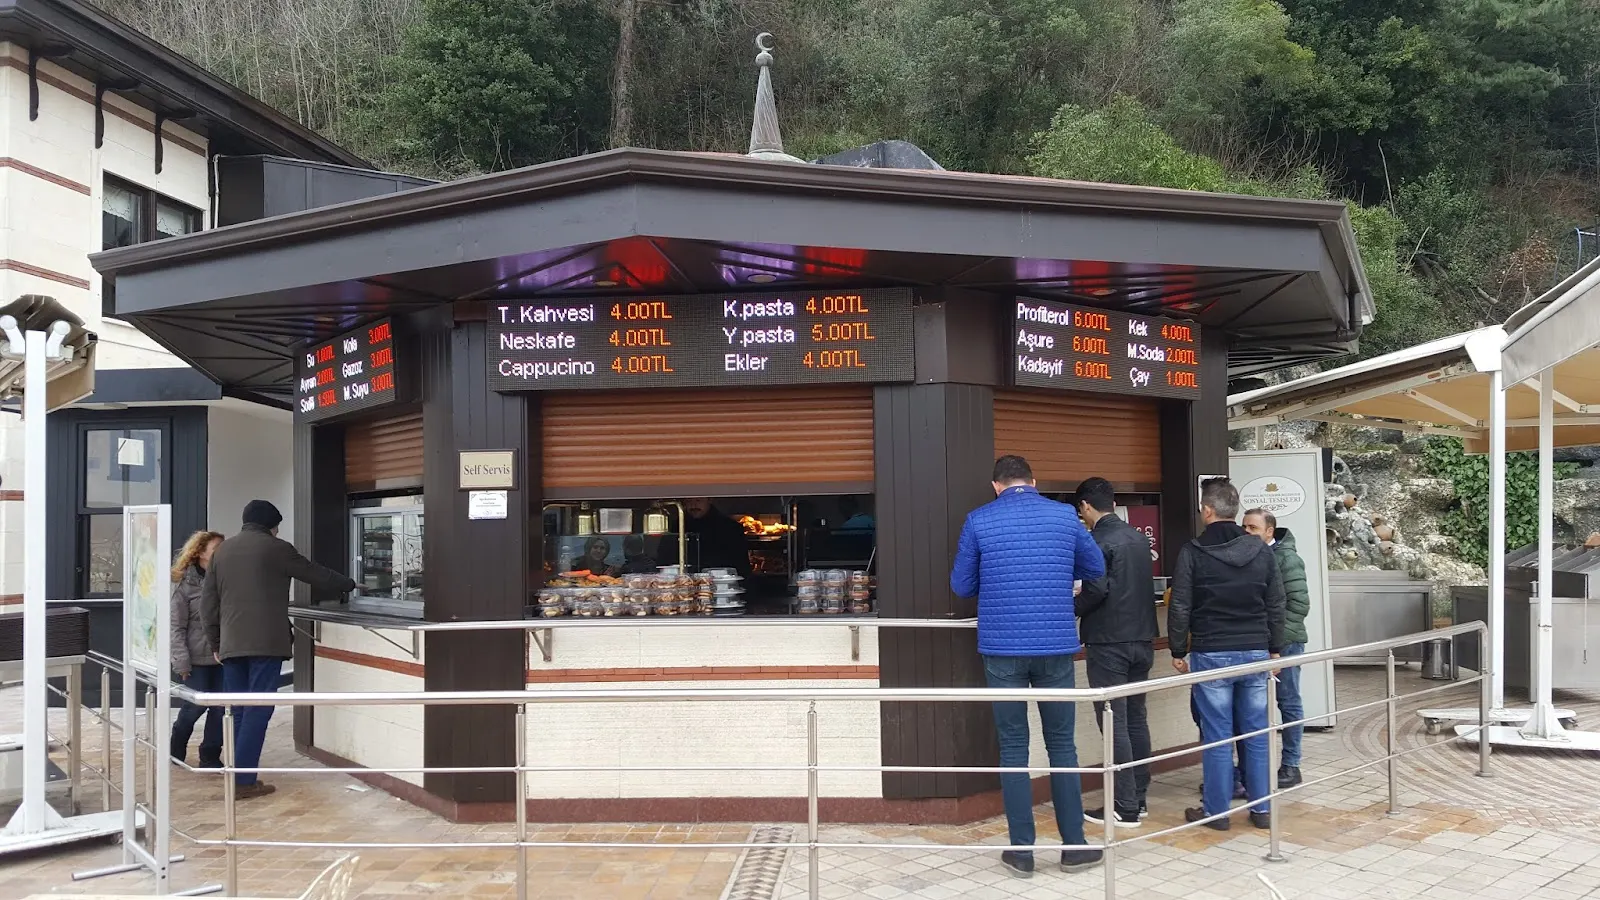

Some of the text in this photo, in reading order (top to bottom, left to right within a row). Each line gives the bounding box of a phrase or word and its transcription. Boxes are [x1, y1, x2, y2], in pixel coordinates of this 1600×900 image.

[498, 302, 672, 324] T. Kahvesi 4.00TL
[723, 296, 869, 321] K.pasta 4.00TL
[1017, 302, 1111, 331] Profiterol 6.00TL
[343, 323, 392, 355] Kola 3.00TL
[500, 328, 671, 350] Neskafe 4.00TL
[722, 322, 875, 348] Y.pasta 5.00TL
[1017, 329, 1110, 355] Aşure 6.00TL
[1128, 319, 1194, 342] Kek 4.00TL
[306, 353, 315, 368] Su
[342, 347, 394, 379] Gazoz 3.00TL
[724, 350, 866, 371] Ekler 4.00TL
[1127, 342, 1199, 365] M.Soda 2.00TL
[499, 355, 673, 380] Cappucino 4.00TL
[1075, 361, 1112, 379] 6.00TL
[1129, 367, 1199, 388] Çay 1.00TL
[300, 376, 317, 393] Ayran
[352, 382, 369, 399] Suyu
[371, 372, 394, 393] 3.00TL
[463, 464, 510, 475] Self Servis
